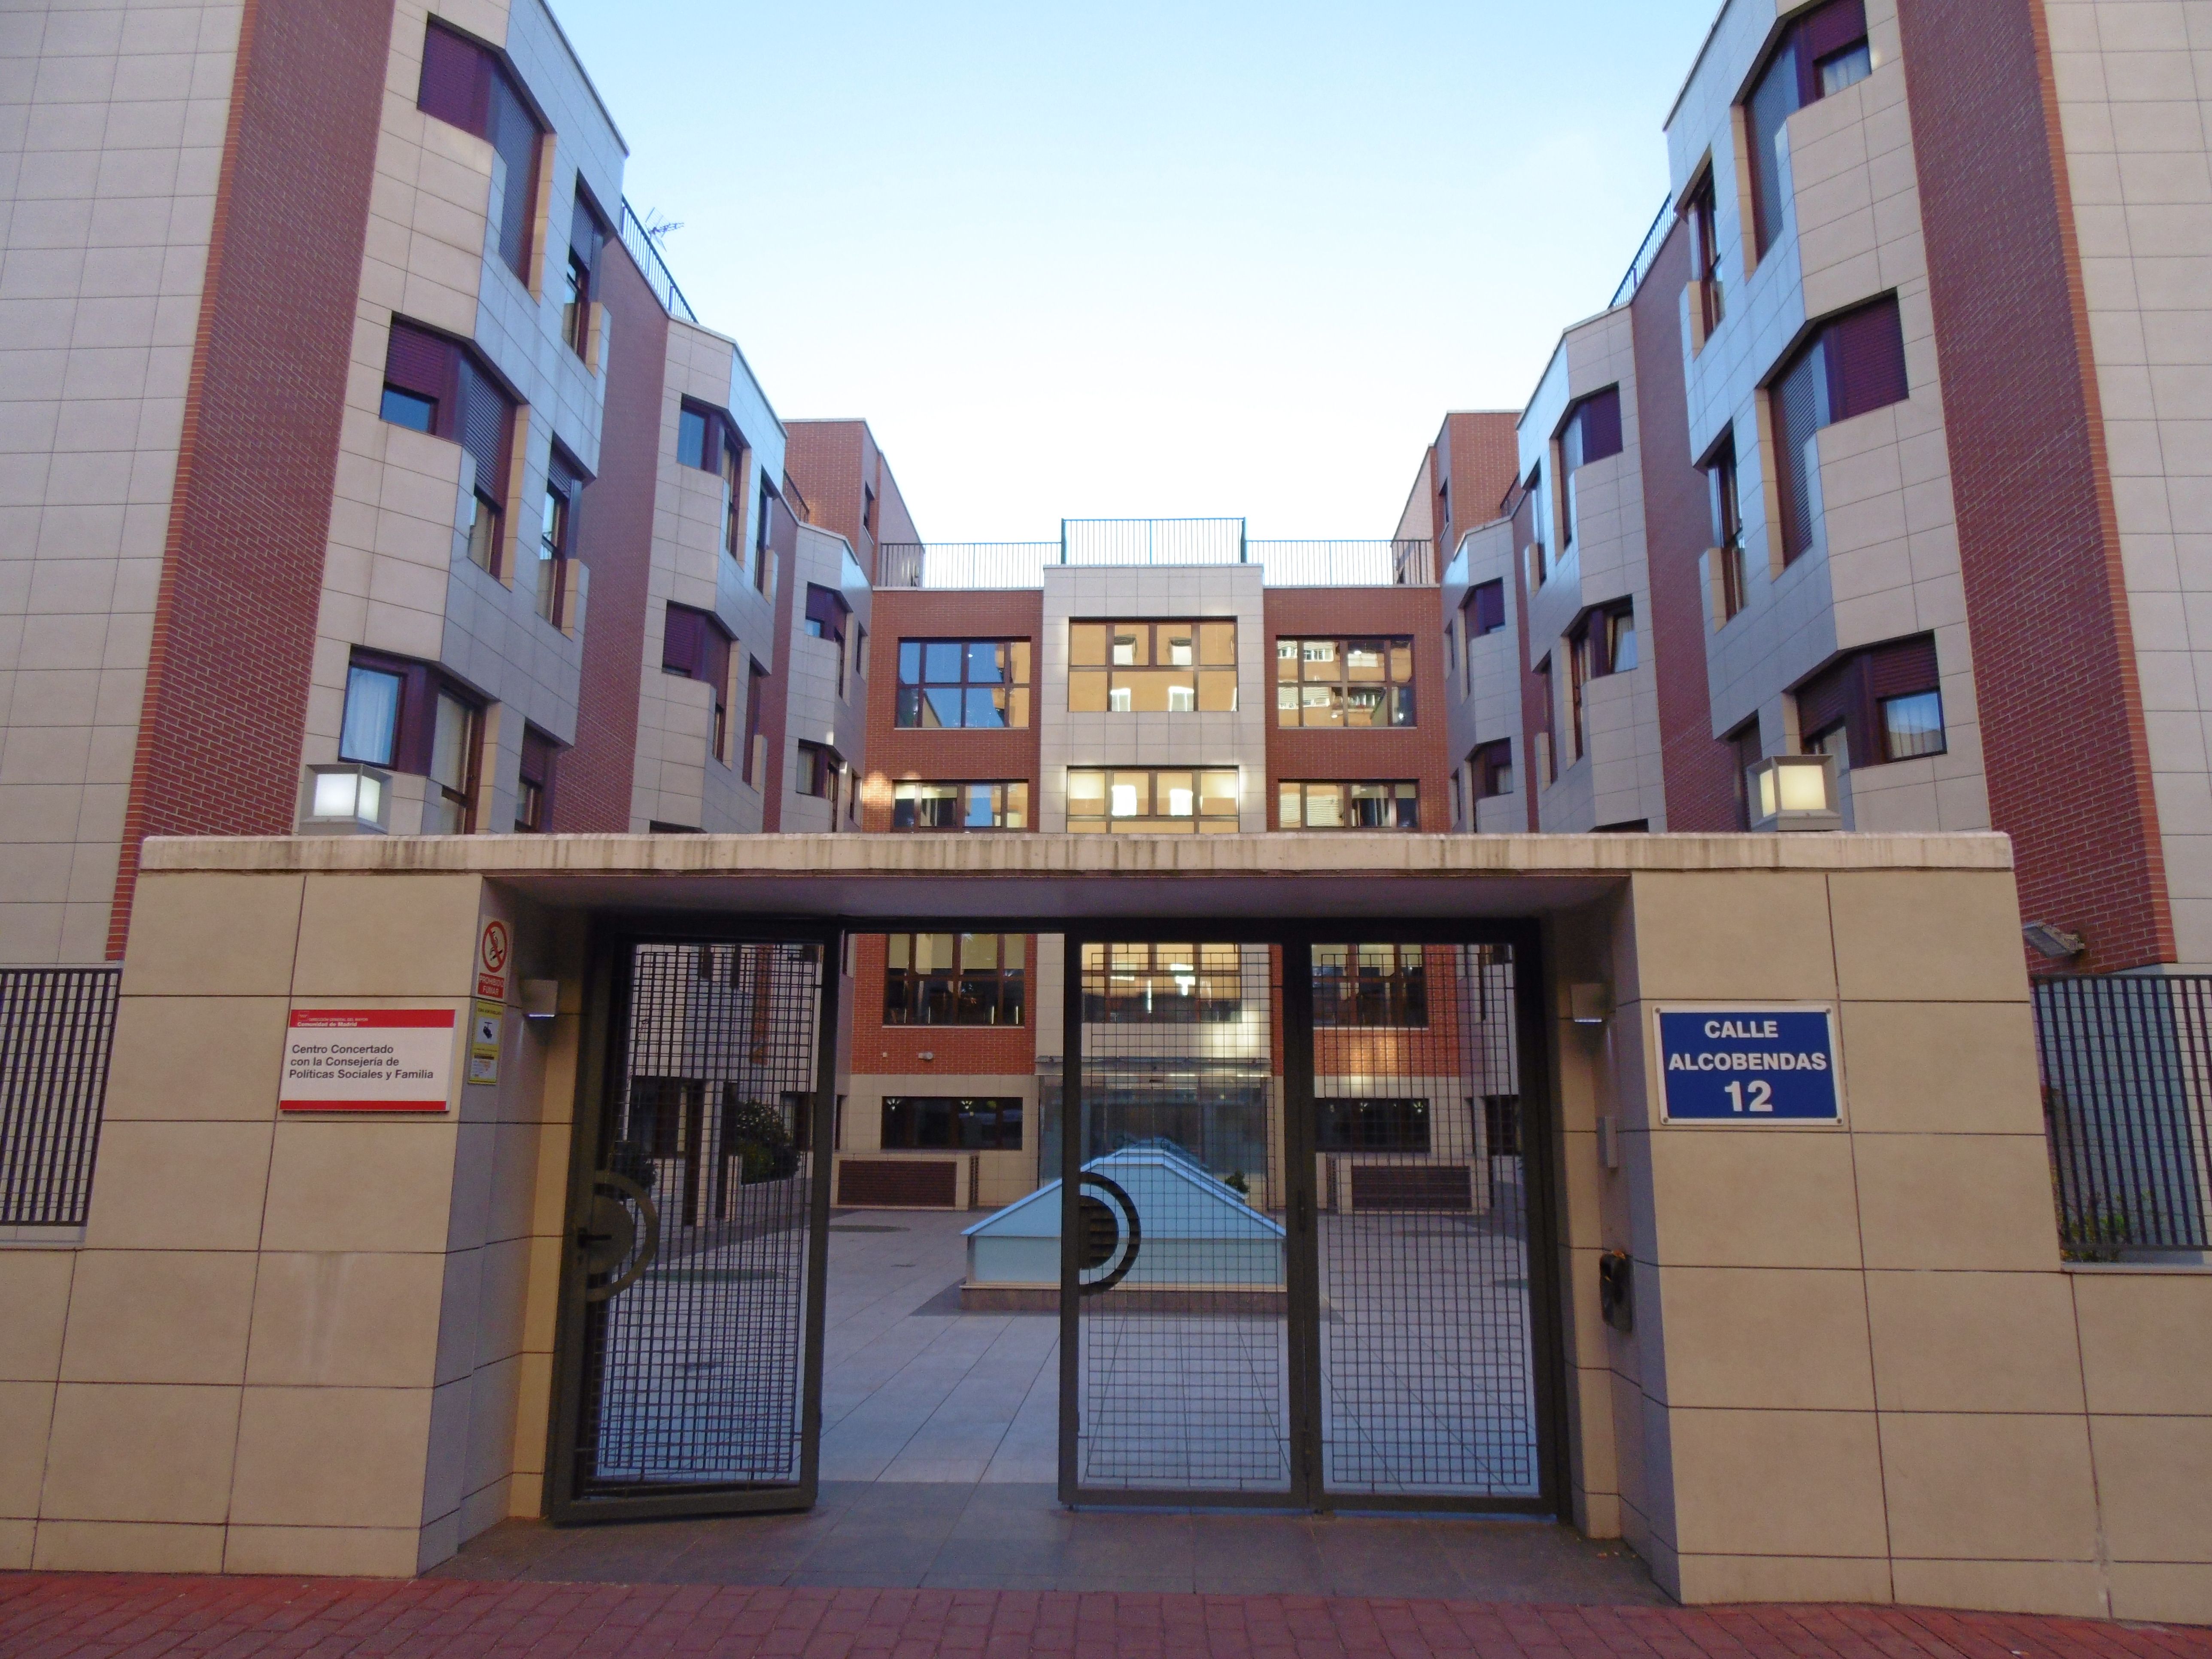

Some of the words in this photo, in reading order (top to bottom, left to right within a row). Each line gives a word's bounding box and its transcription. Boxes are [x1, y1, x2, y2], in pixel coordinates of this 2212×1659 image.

[1704, 1021, 1778, 1038] CALLE
[292, 1044, 328, 1054] Centro
[331, 1044, 394, 1054] Concertado
[313, 1057, 322, 1066] la
[326, 1057, 383, 1068] Consejería
[386, 1057, 399, 1066] de
[1668, 1052, 1826, 1071] ALCOBENDAS
[289, 1069, 334, 1079] Políticas
[337, 1069, 383, 1079] Sociales
[386, 1071, 392, 1081] y
[395, 1069, 433, 1079] Familia
[1724, 1080, 1773, 1112] 12
